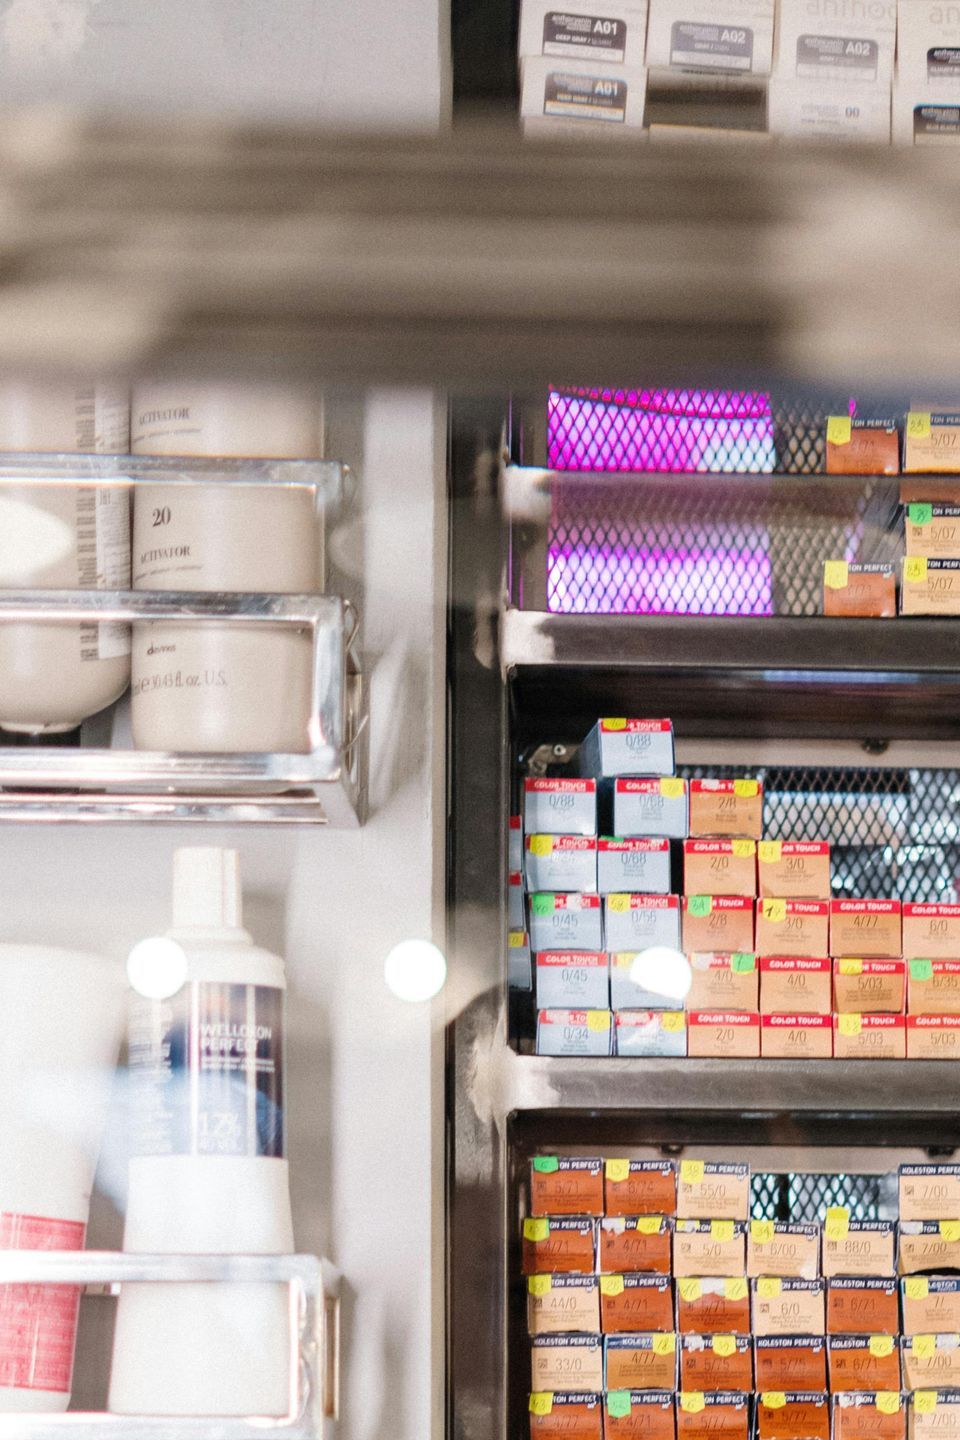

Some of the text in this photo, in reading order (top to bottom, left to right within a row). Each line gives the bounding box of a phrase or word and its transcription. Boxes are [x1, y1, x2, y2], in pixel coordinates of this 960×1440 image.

[594, 21, 618, 35] A01
[721, 30, 745, 43] A02
[845, 43, 870, 56] A02
[595, 81, 618, 95] A01
[931, 434, 956, 446] 5/07
[153, 506, 171, 527] 20
[931, 527, 956, 539] 5/07
[928, 577, 952, 589] 5/07
[621, 853, 646, 865] 0/68
[710, 857, 729, 870] 2/0
[785, 858, 804, 871] 3/0
[841, 903, 892, 913] COLOR TOUCH
[912, 907, 935, 915] COLOR
[553, 915, 578, 928] 0/45
[854, 915, 878, 927] 4/77
[930, 920, 948, 932] 6/0
[546, 956, 598, 965] COLOR TOUCH
[770, 961, 821, 970] COLOR TOUCH
[561, 971, 587, 983] 0/45
[787, 974, 806, 987] 4/0
[697, 1016, 750, 1024] COLOR TOUCH
[916, 1018, 940, 1026] COLOR
[563, 1028, 589, 1040] 0/34
[716, 1029, 734, 1041] 2/0
[788, 1030, 806, 1042] 4/0
[931, 1033, 956, 1045] 5/03
[902, 1166, 933, 1174] KOLESTON
[701, 1185, 725, 1196] 55/0
[923, 1185, 948, 1198] 7/00
[703, 1244, 721, 1256] 5/0
[845, 1241, 871, 1253] 88/0
[831, 1281, 894, 1290] KOLESTON PERFECT
[551, 1298, 576, 1310] 44/0
[781, 1303, 800, 1315] 6/0
[534, 1338, 598, 1347] KOLESTON PERFECT
[556, 1358, 582, 1370] 33/0
